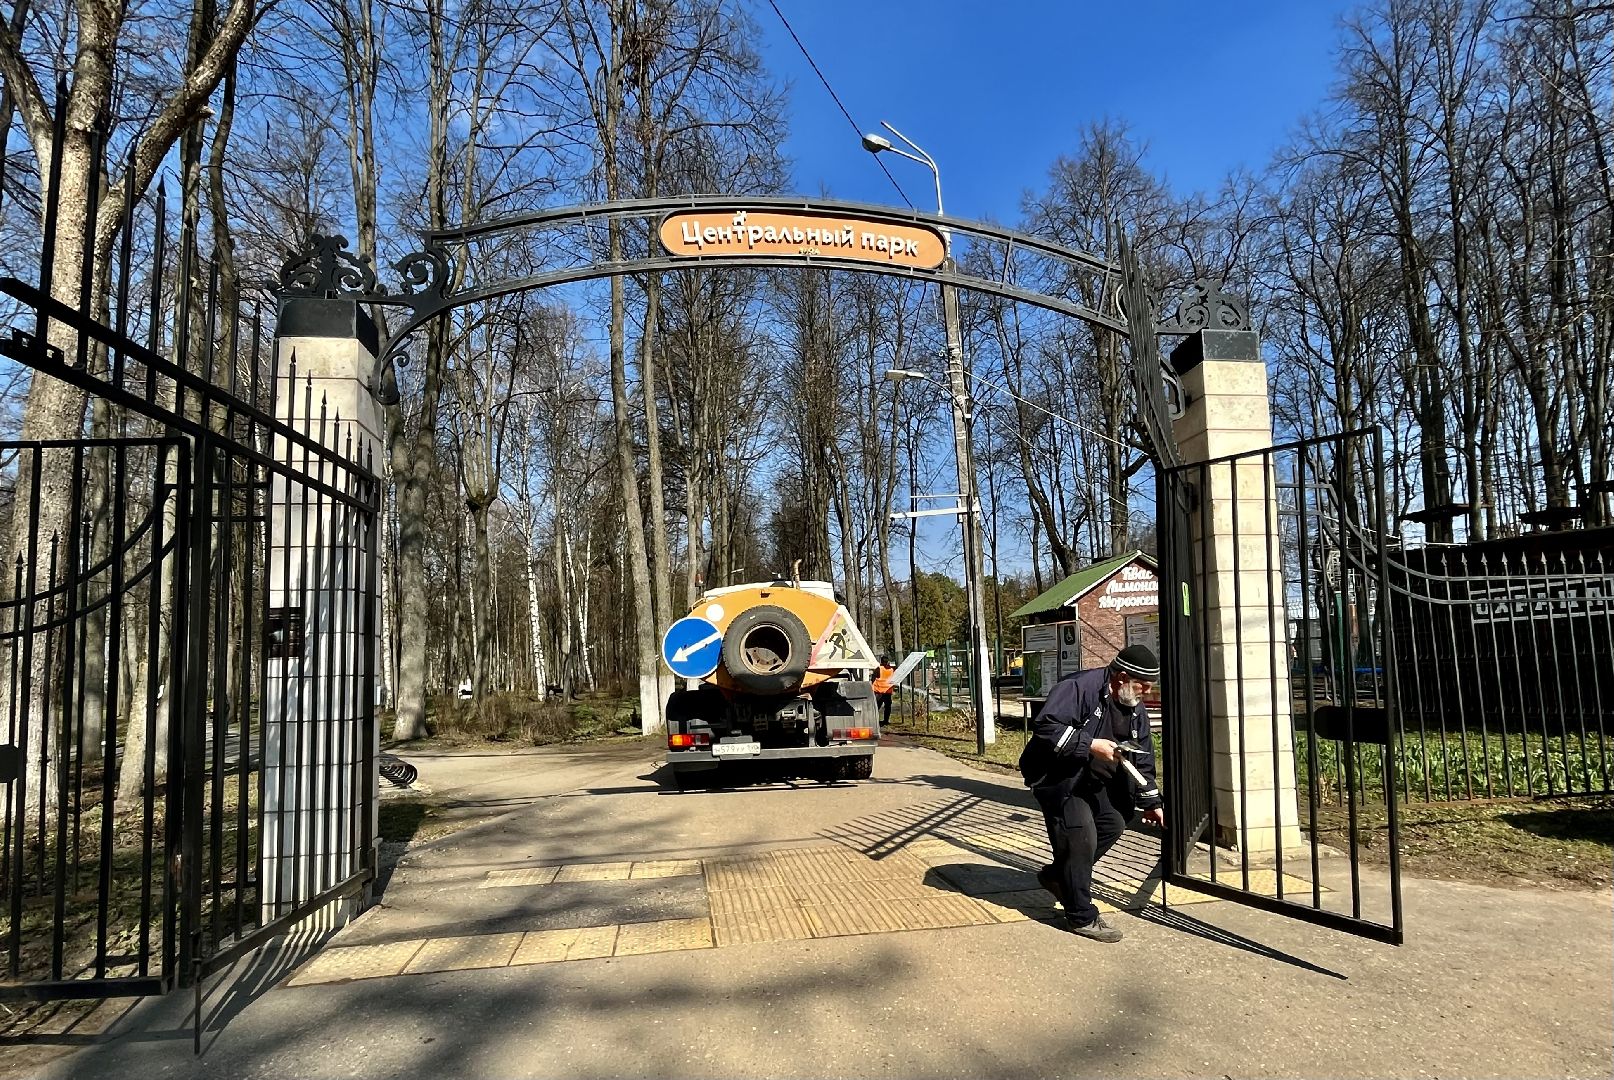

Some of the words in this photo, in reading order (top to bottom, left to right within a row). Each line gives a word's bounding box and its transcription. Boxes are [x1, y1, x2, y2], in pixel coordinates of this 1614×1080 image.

[681, 220, 855, 249] Центральный
[861, 233, 919, 258] парк
[1120, 566, 1154, 580] Квас
[1105, 579, 1158, 595] Лимона
[1098, 594, 1158, 612] Морожен
